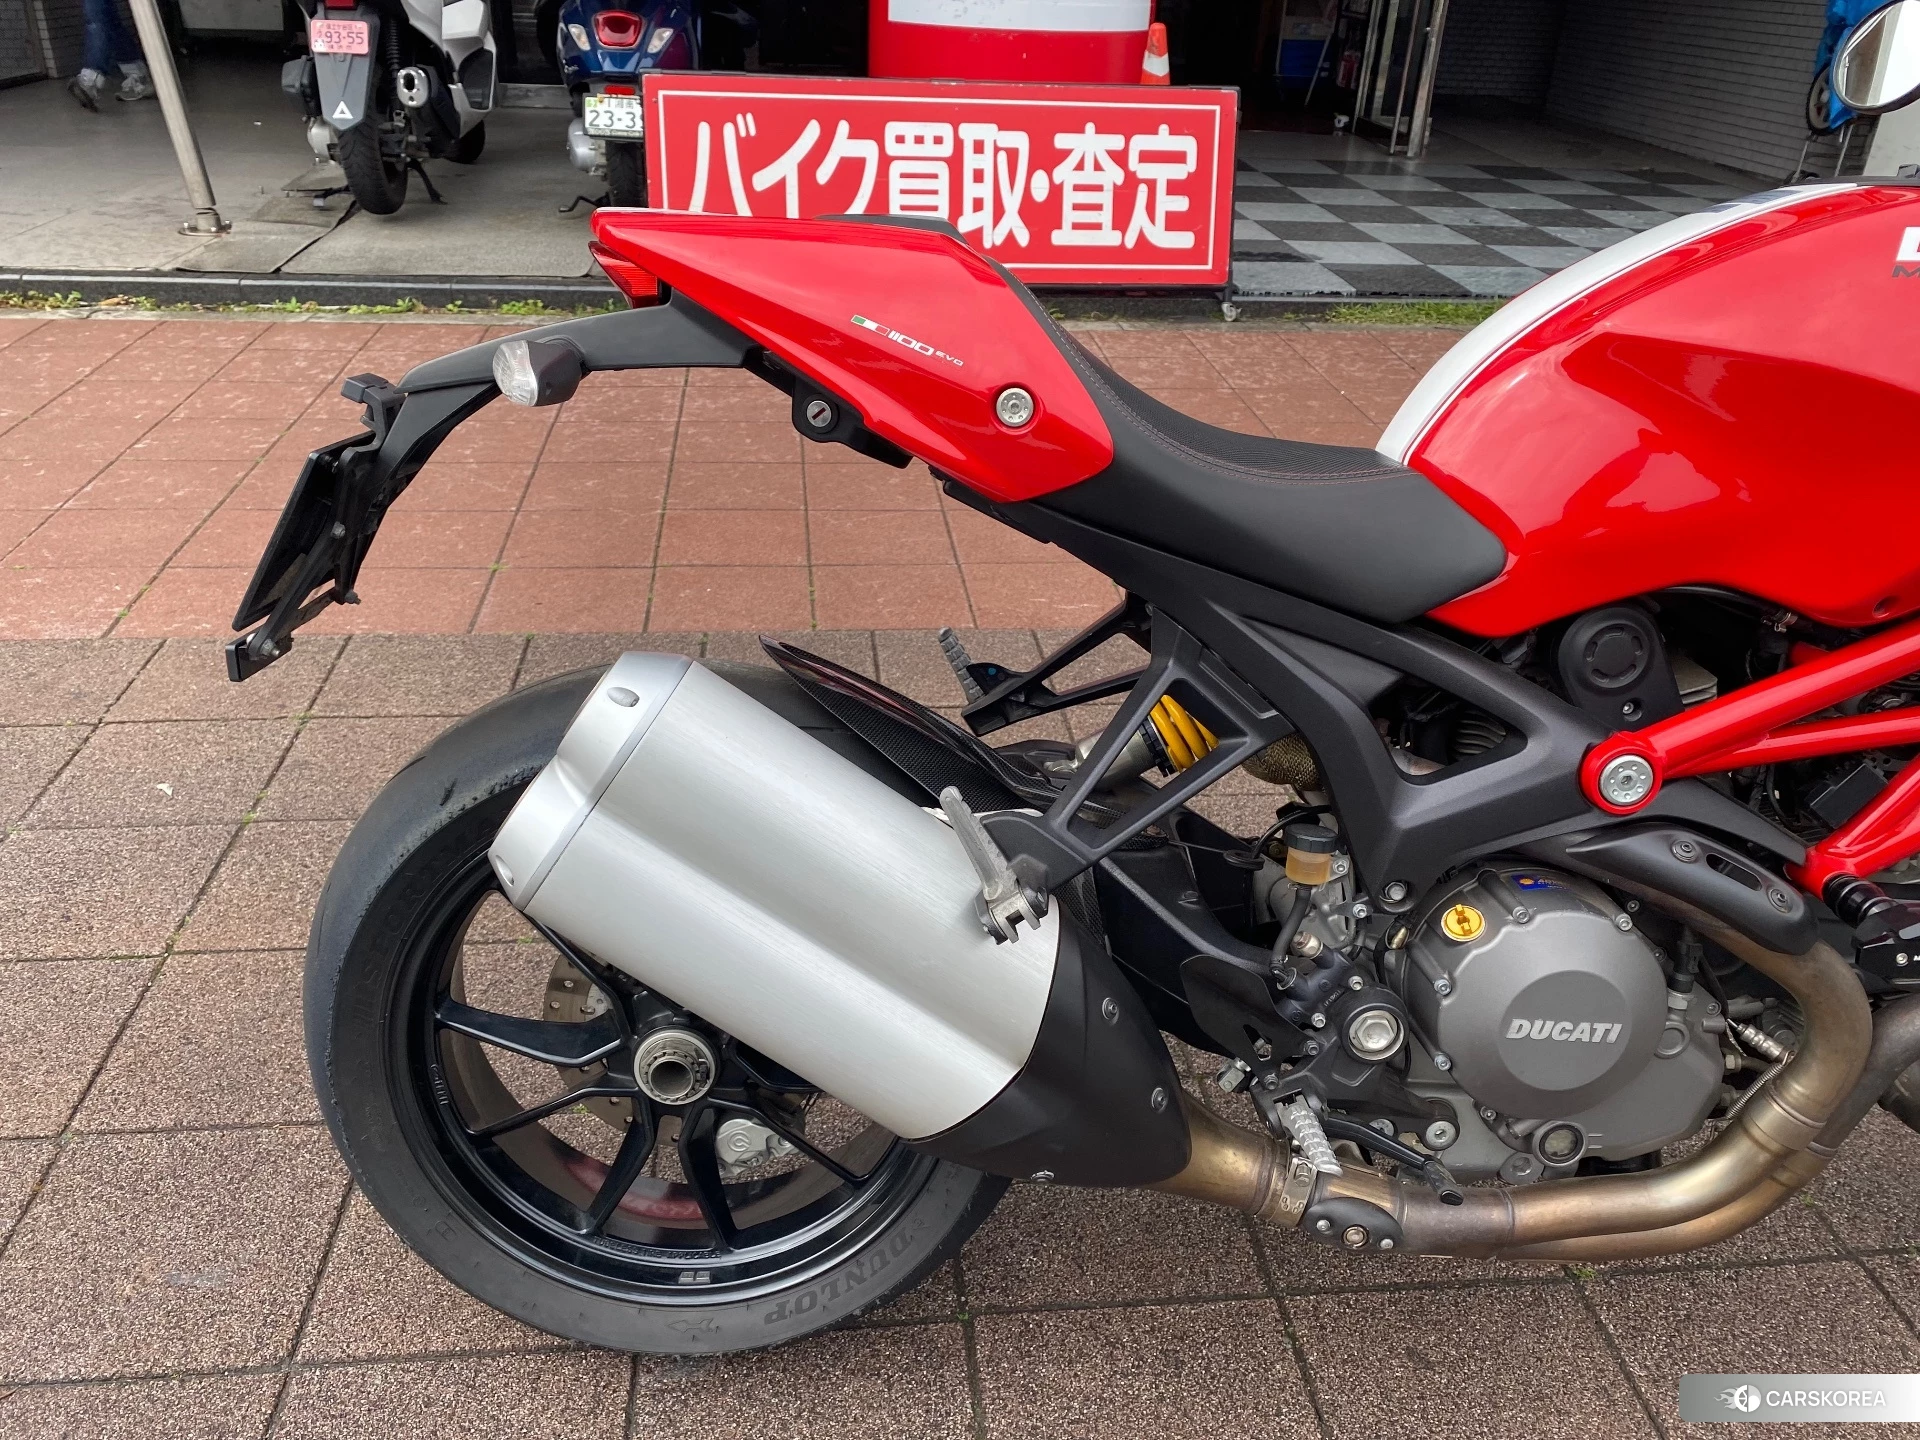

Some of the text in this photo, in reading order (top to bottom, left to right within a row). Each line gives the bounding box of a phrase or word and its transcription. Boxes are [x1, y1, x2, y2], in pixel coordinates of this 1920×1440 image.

[688, 112, 1198, 249] バイク買取・査定
[887, 330, 935, 356] 1100
[1506, 1018, 1623, 1044] DUCATI
[764, 1227, 913, 1325] DUNLOP
